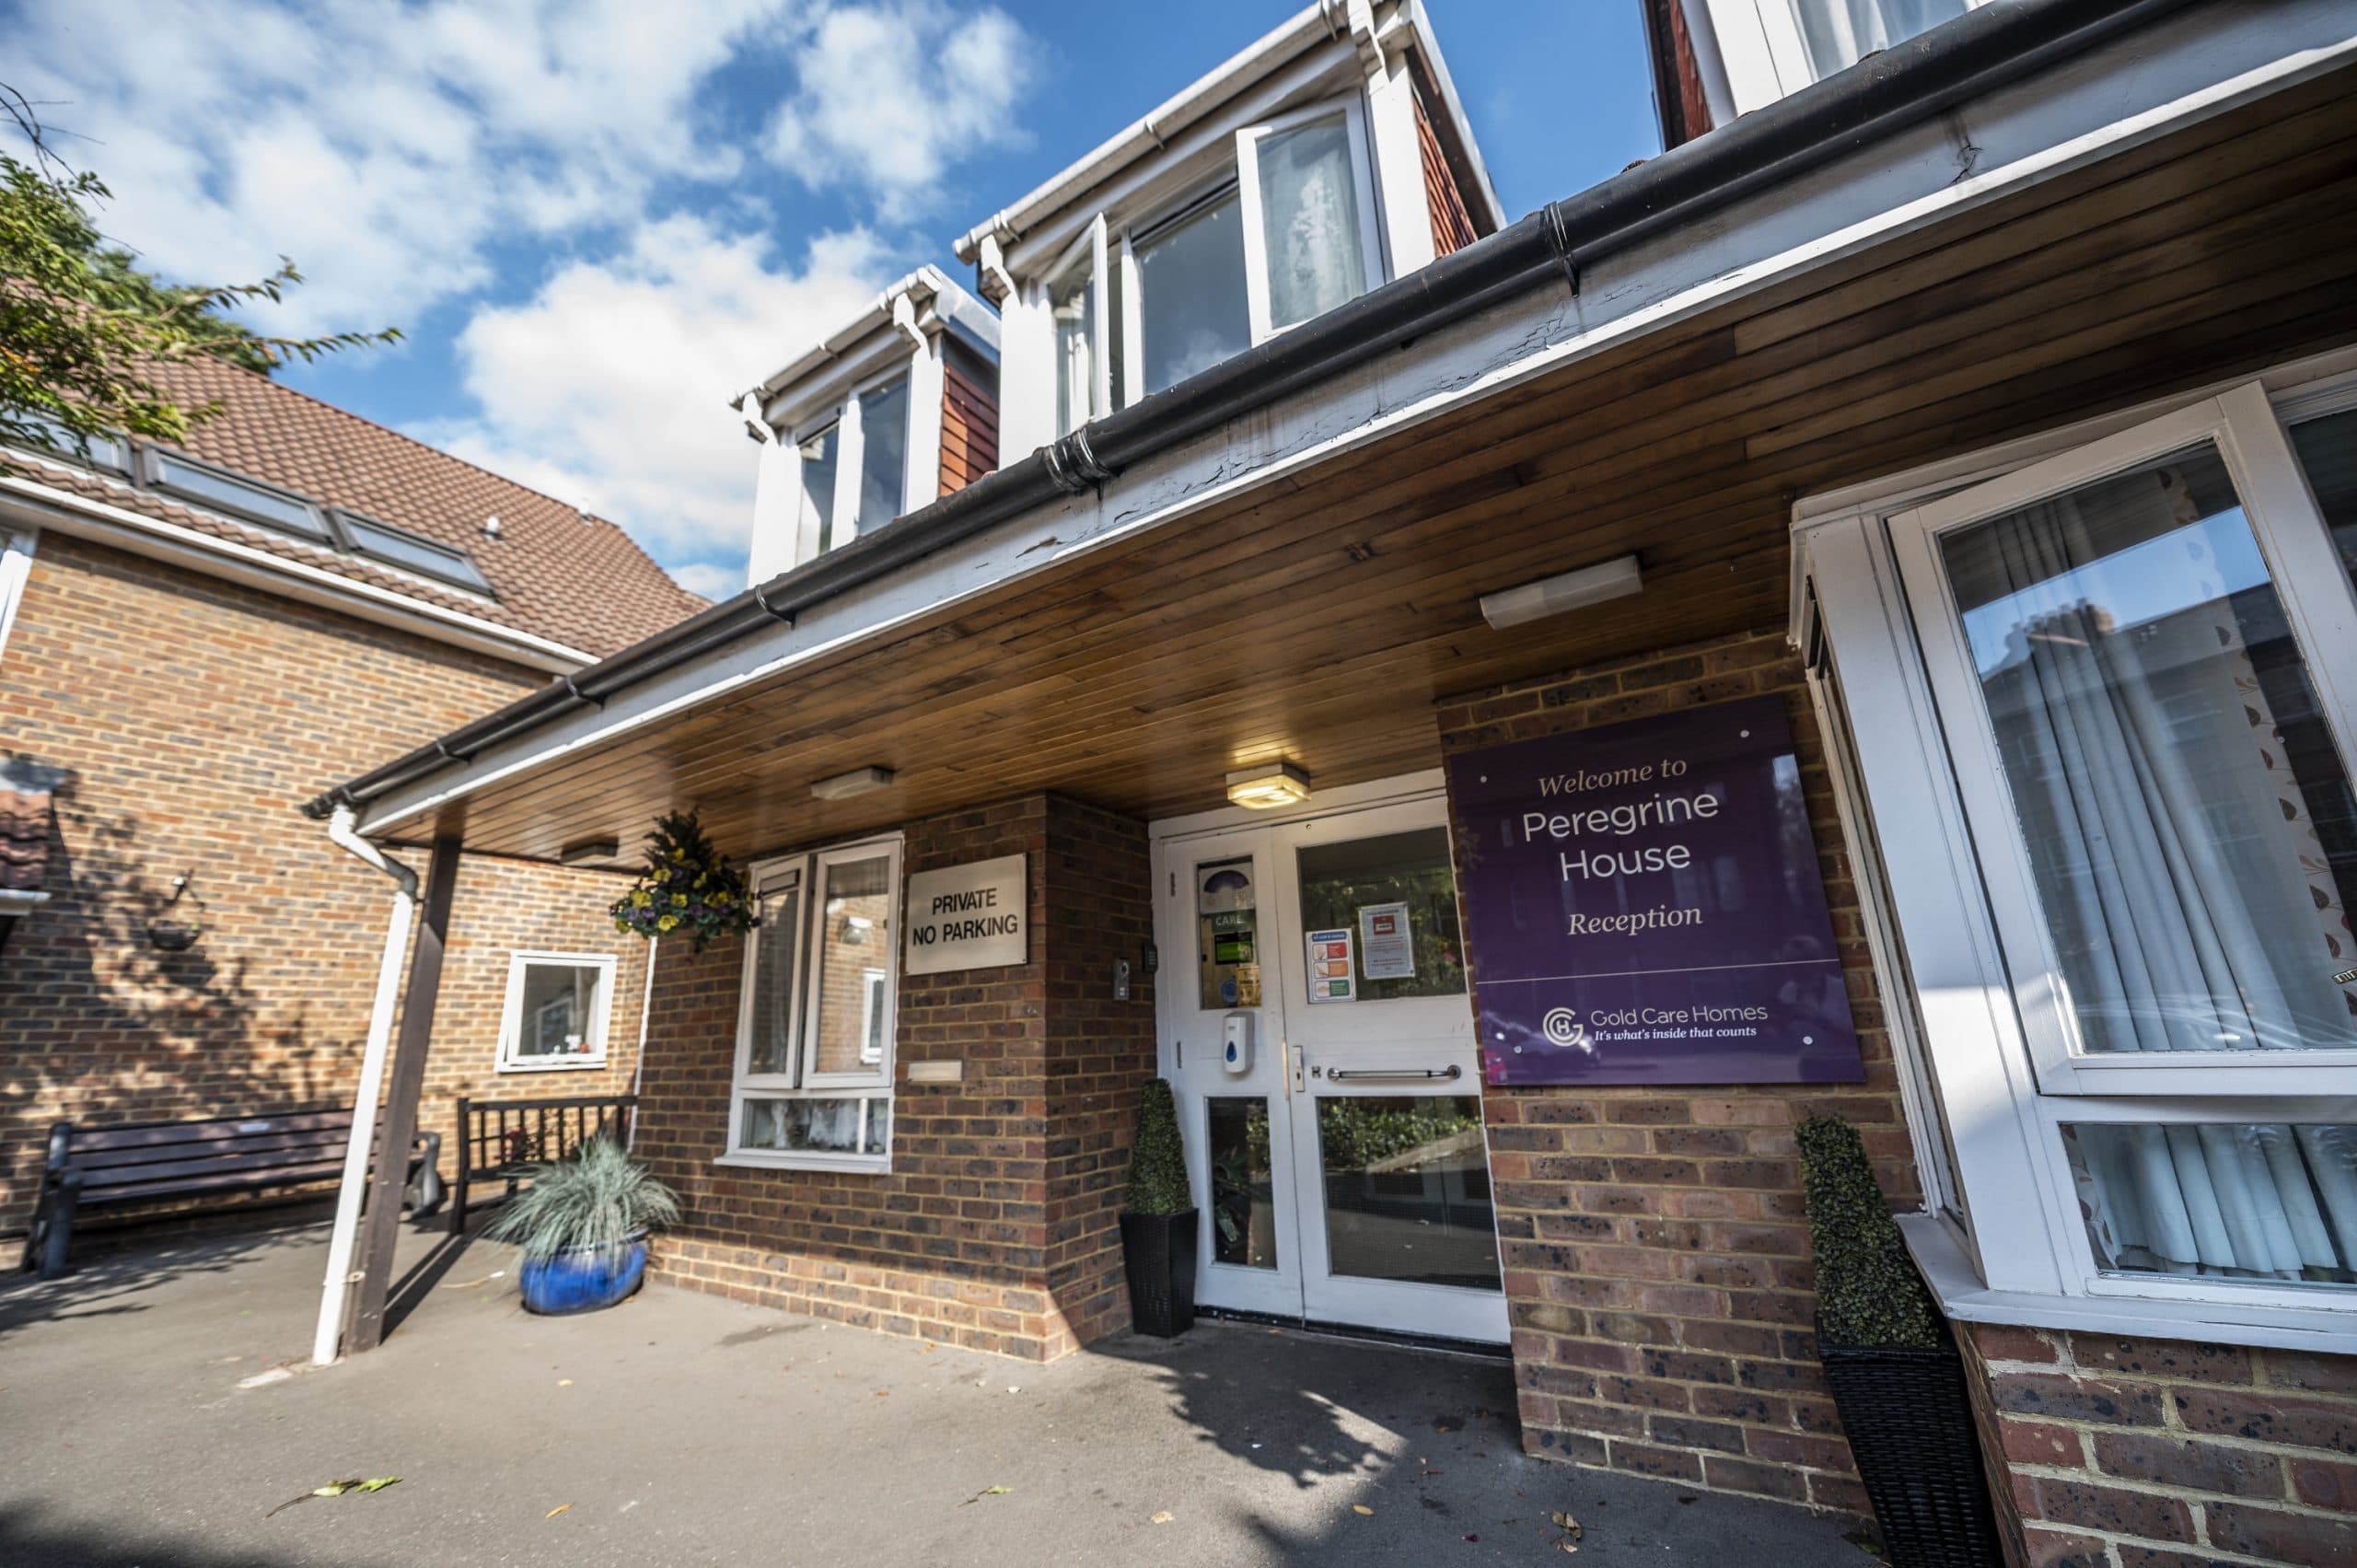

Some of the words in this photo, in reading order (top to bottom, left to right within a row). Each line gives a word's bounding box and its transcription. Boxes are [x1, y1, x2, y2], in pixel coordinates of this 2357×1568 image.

[1538, 763, 1654, 797] Welcome
[1660, 759, 1688, 779] to
[1523, 792, 1719, 842] Peregrine
[1560, 844, 1691, 882] House
[932, 888, 997, 916] PRIVATE
[912, 925, 936, 947] NO
[942, 913, 1018, 943] PARKING
[1567, 904, 1703, 936] Reception
[1591, 1009, 1637, 1027] Gold
[1642, 1007, 1689, 1024] Care
[1691, 1005, 1768, 1023] Homes
[1595, 1029, 1611, 1041] It's
[1614, 1028, 1650, 1040] what's
[1652, 1027, 1687, 1039] inside
[1689, 1027, 1713, 1038] that
[1716, 1026, 1758, 1038] counts
